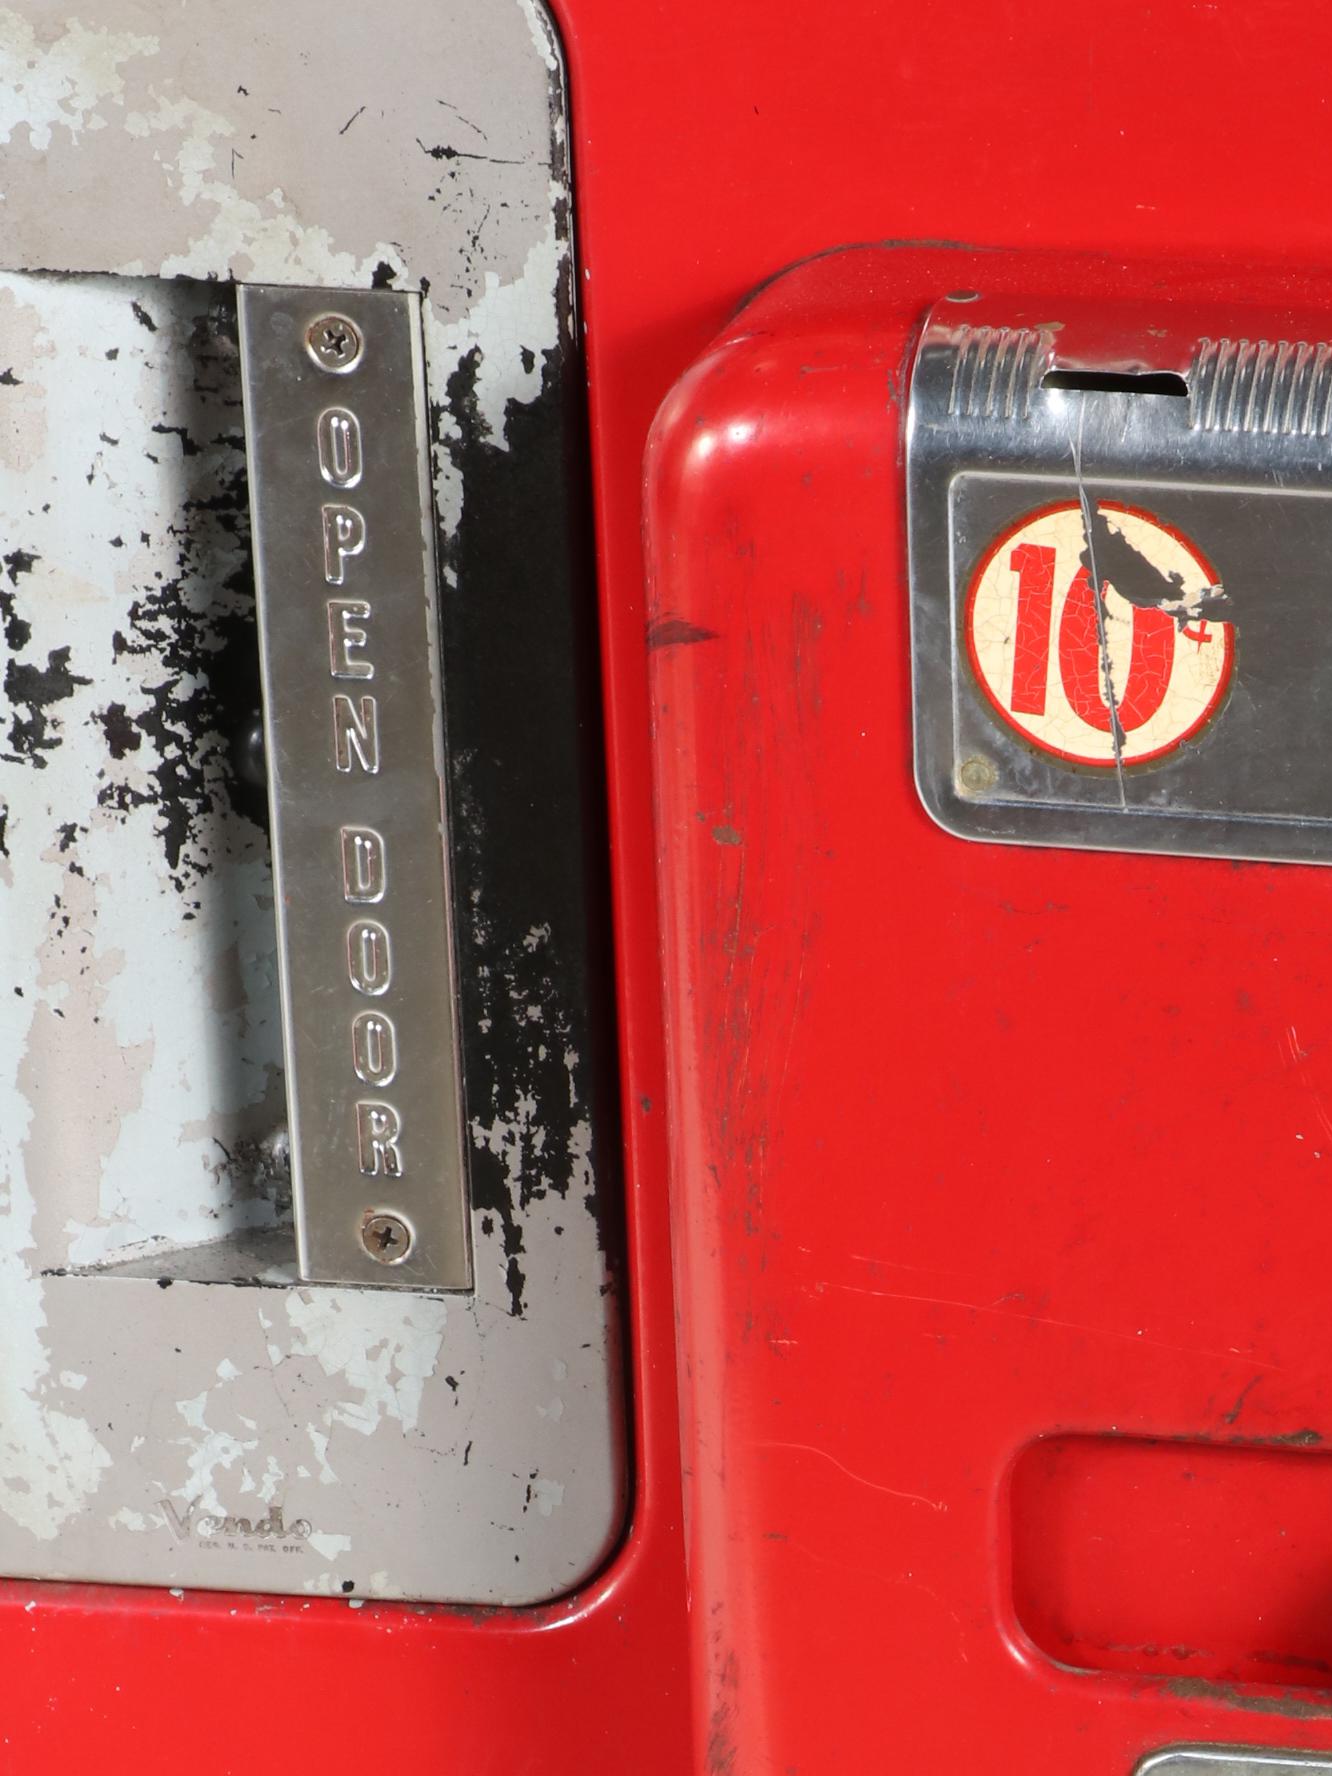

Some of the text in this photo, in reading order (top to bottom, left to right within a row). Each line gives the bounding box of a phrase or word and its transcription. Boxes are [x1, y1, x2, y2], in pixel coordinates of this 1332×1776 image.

[317, 407, 402, 1178] OPEN DOOR
[154, 1495, 312, 1543] Vendo
